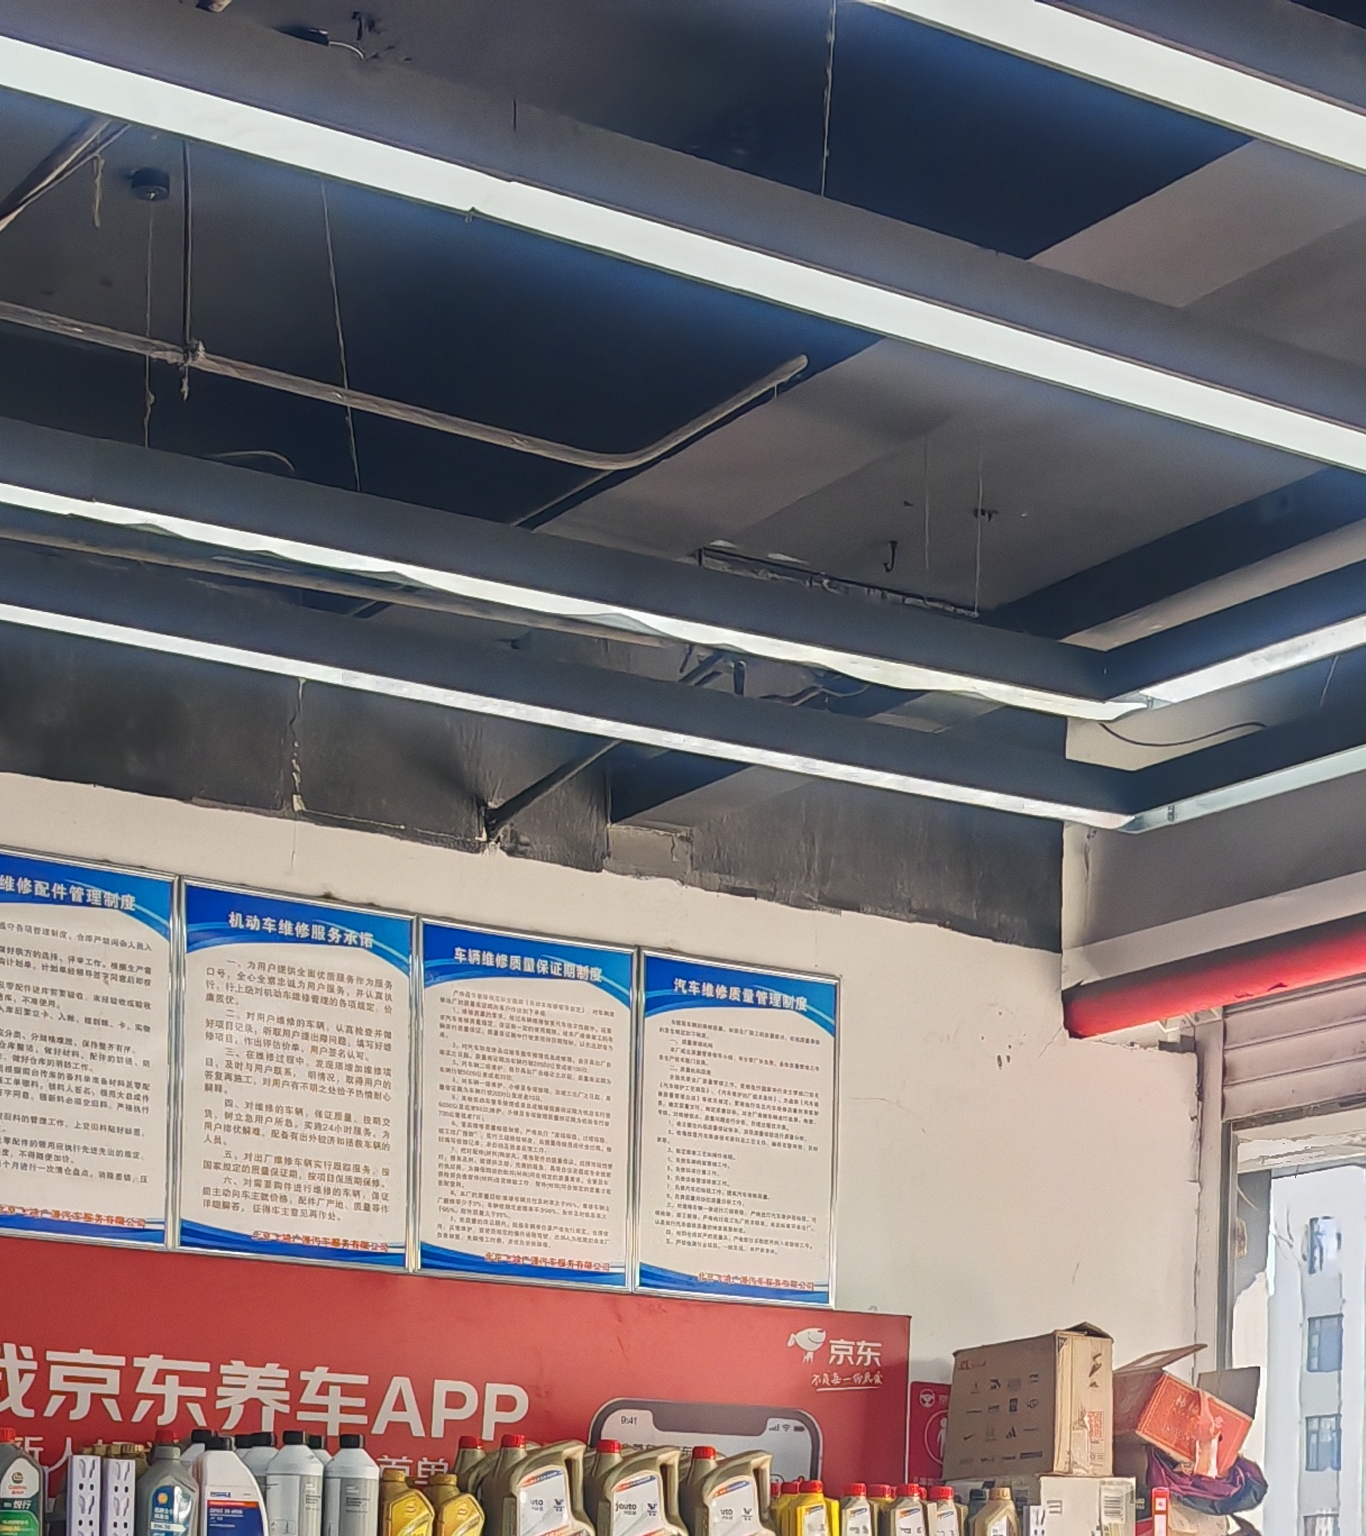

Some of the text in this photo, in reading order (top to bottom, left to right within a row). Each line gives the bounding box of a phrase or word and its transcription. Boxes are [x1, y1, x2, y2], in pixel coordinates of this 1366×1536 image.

[229, 912, 374, 948] 机动车维修服务承诺
[454, 947, 602, 982] 车辆维修质量保证期制度
[674, 978, 807, 1011] 汽车维修质量管理制度
[829, 1339, 882, 1367] 京东
